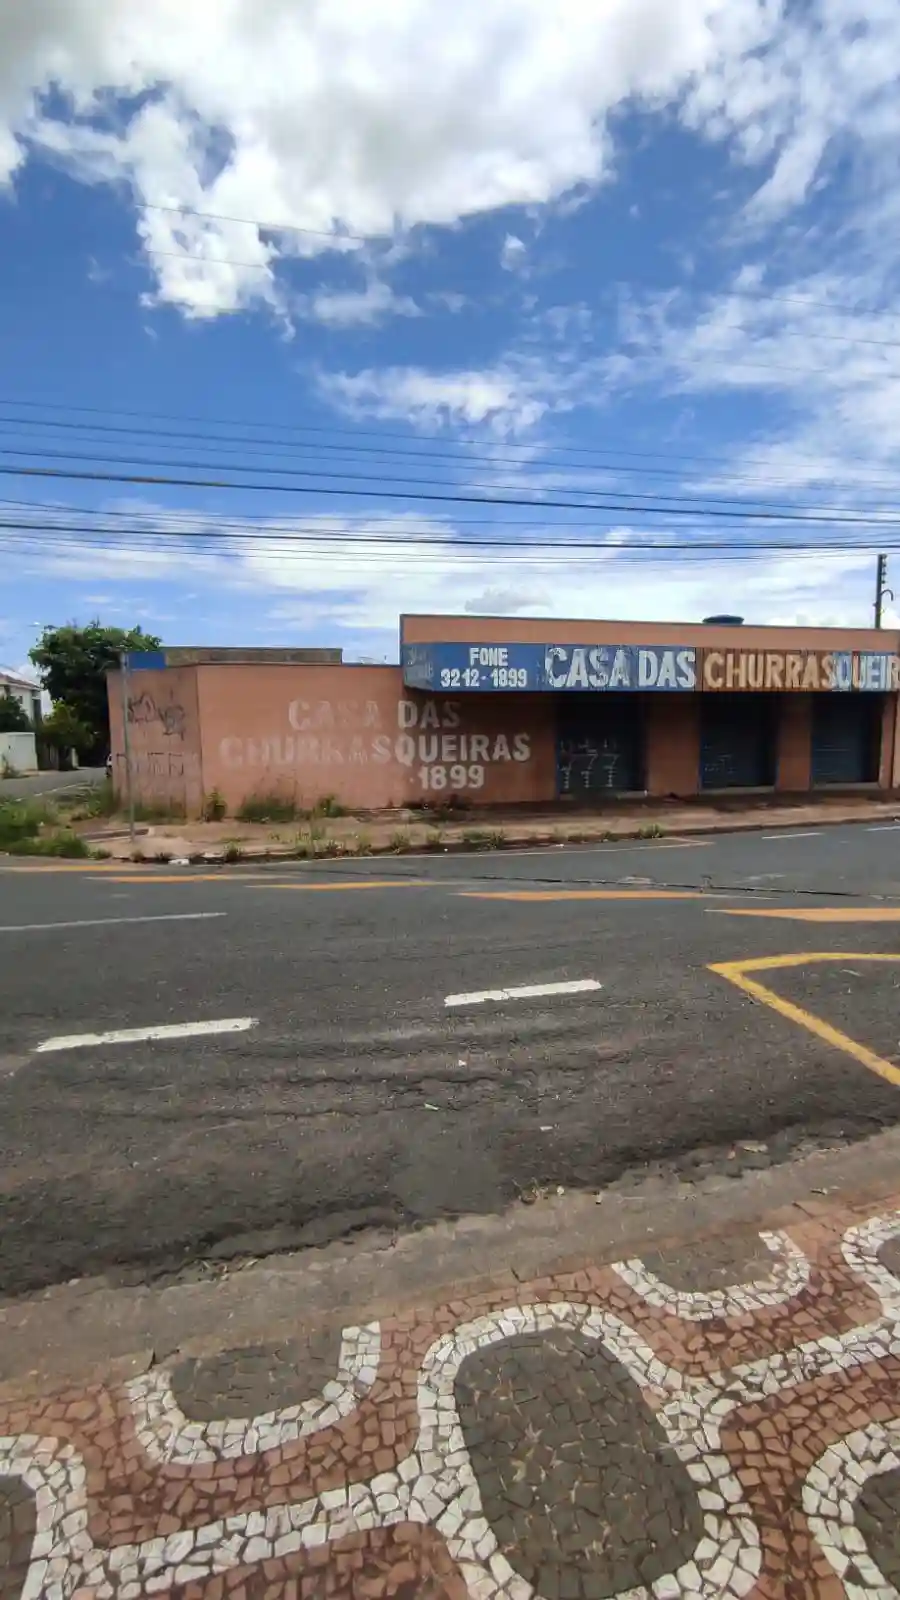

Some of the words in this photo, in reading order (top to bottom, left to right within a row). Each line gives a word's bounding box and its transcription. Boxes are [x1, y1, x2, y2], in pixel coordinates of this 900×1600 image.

[469, 647, 508, 667] FONE
[544, 647, 631, 688] CASA
[638, 650, 697, 688] DAS
[397, 699, 461, 728] DAS
[418, 764, 485, 790] 1899
